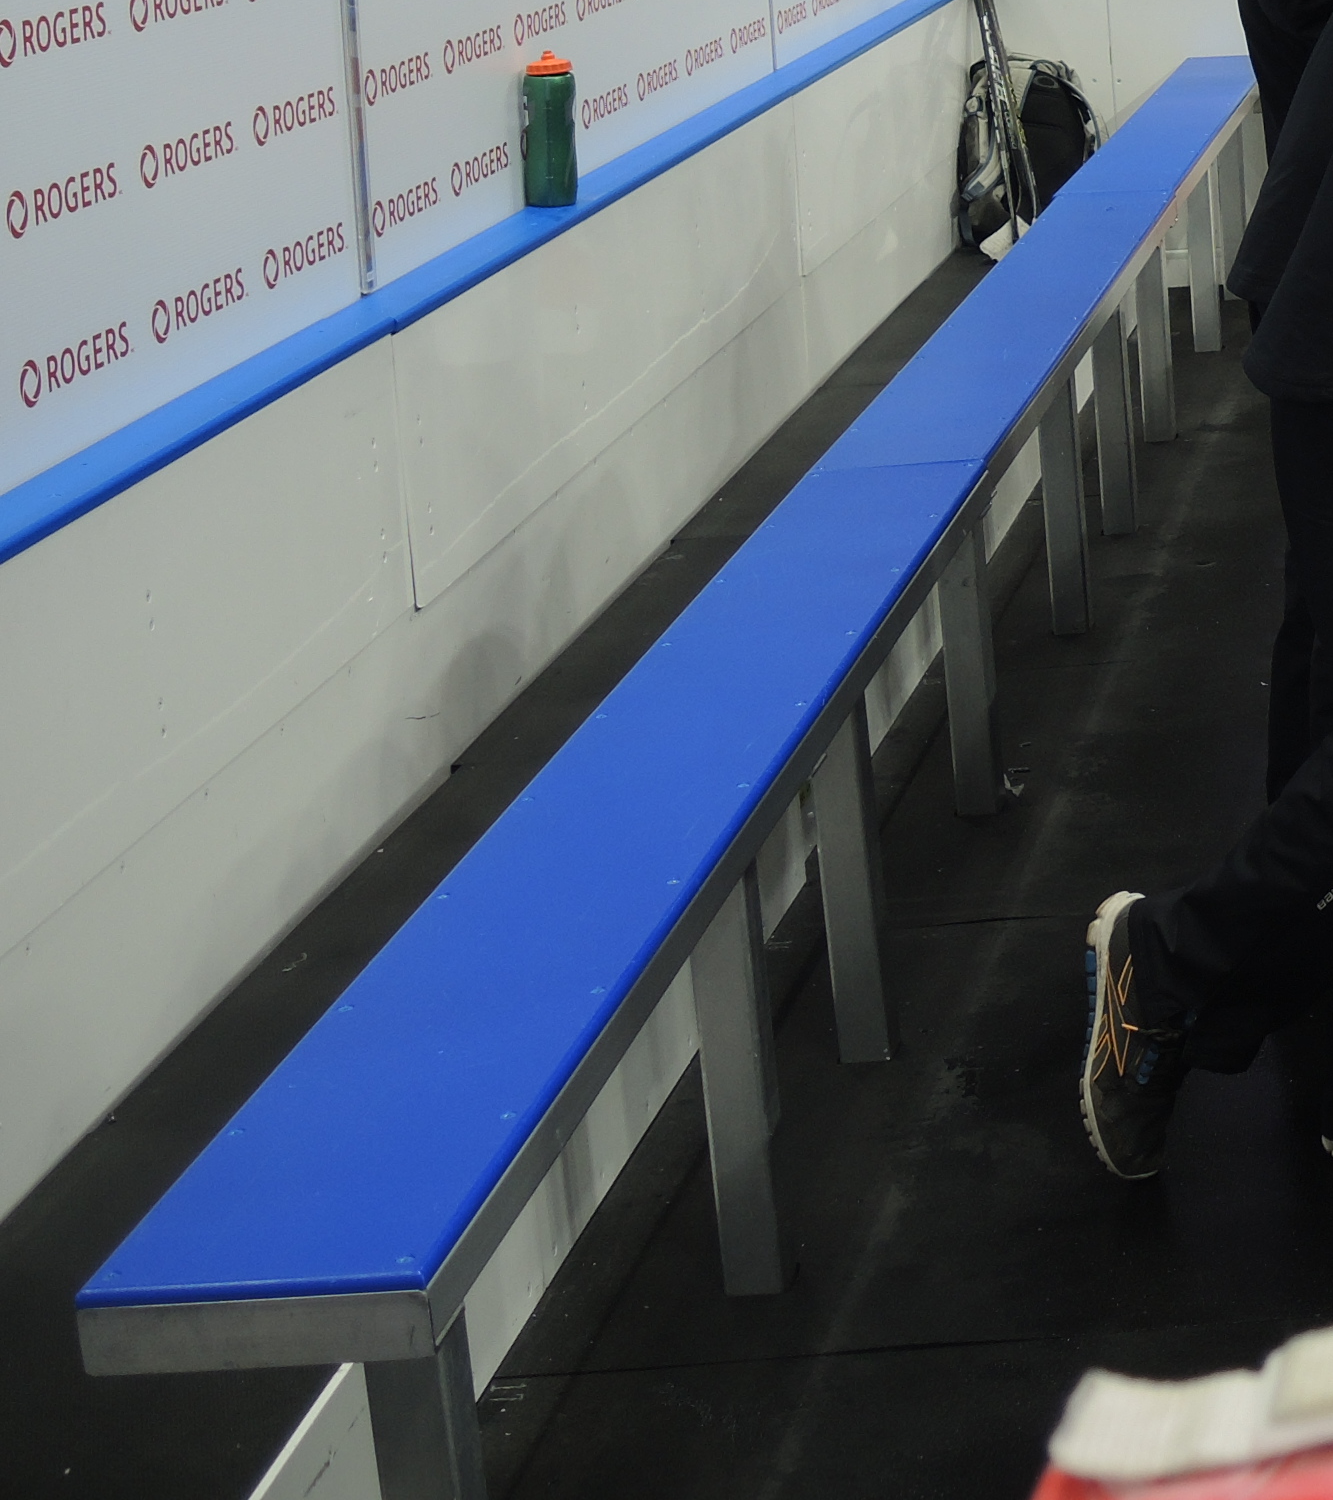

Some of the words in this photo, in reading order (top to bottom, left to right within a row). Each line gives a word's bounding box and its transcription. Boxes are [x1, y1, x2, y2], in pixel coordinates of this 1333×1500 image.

[22, 1, 108, 57] ROGERS
[380, 51, 431, 98] ROGERS
[457, 24, 502, 64] ROGERS
[526, 1, 567, 39] ROGERS
[35, 162, 118, 226] ROGERS
[163, 121, 234, 178] ROGERS
[273, 85, 336, 137] ROGERS
[388, 177, 439, 228] ROGERS
[464, 141, 510, 188] ROGERS
[593, 83, 628, 123] ROGERS
[48, 321, 131, 393] ROGERS
[174, 267, 246, 330] ROGERS
[283, 221, 346, 279] ROGERS
